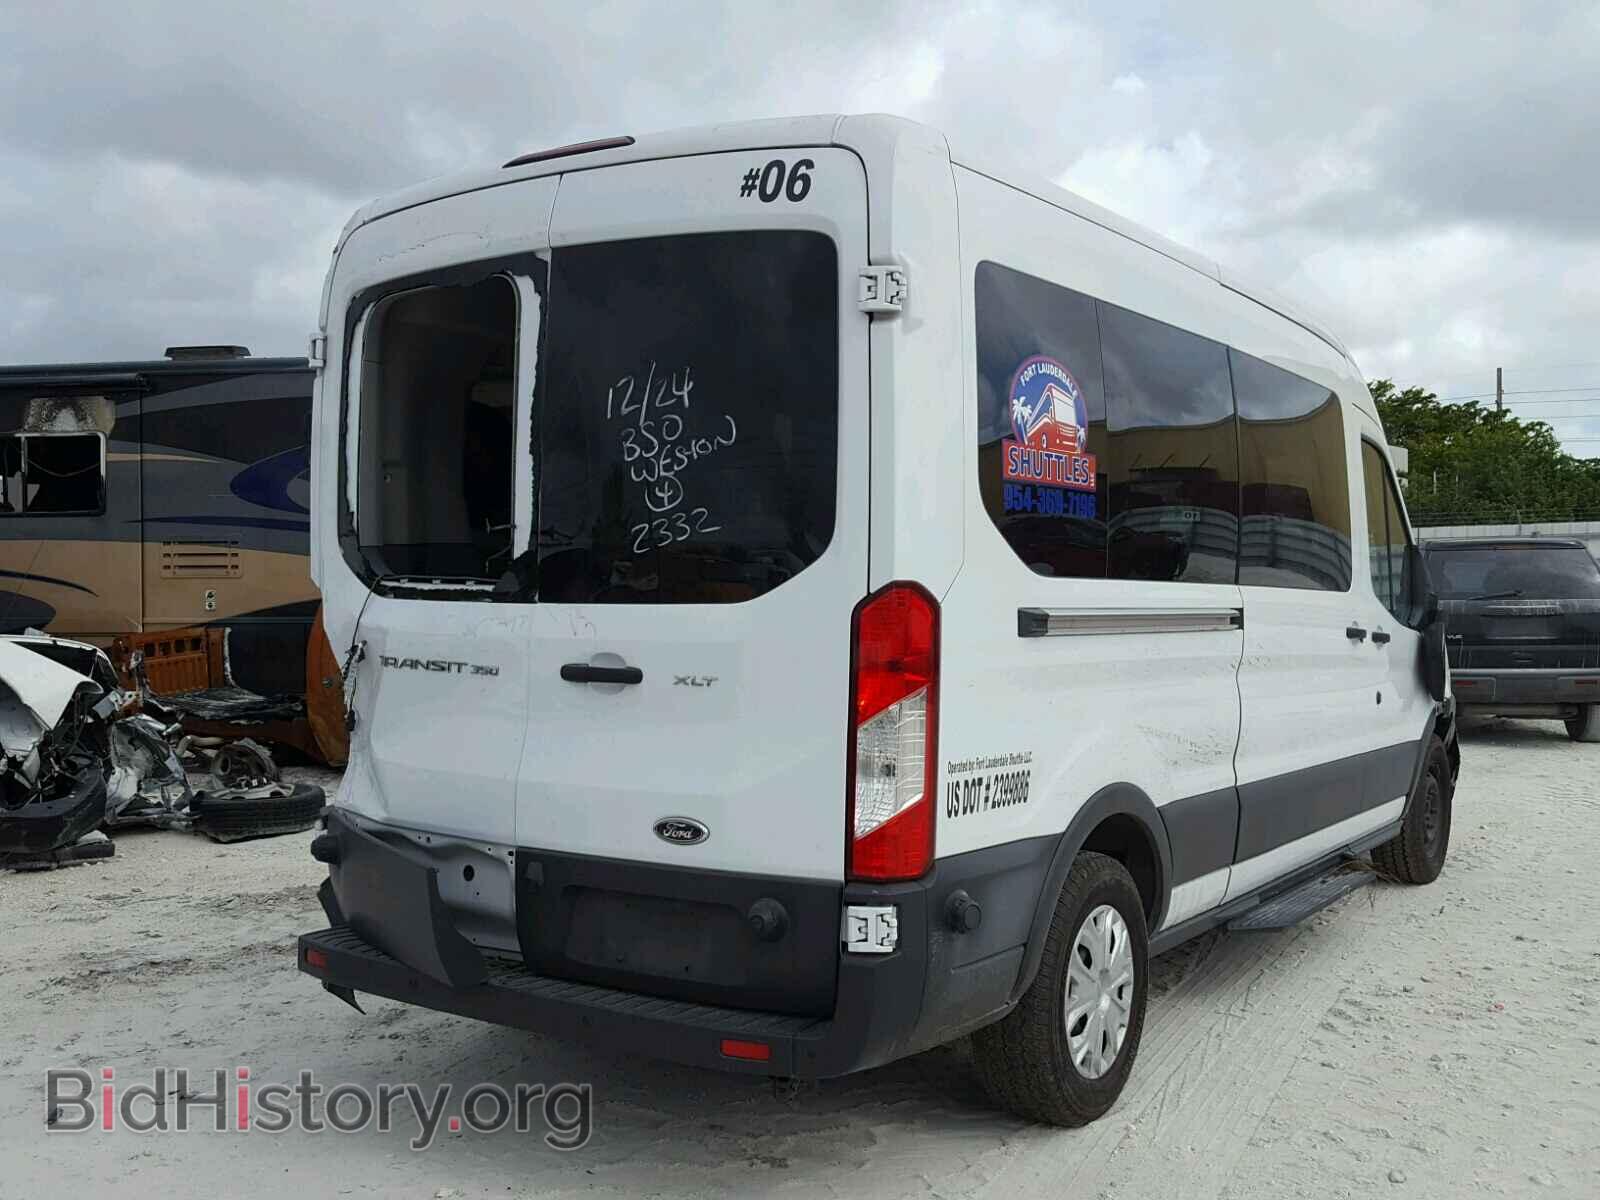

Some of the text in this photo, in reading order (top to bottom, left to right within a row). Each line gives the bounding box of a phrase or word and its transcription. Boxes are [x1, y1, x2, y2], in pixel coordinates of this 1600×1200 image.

[740, 158, 815, 203] #06
[606, 359, 694, 426] 12/24
[1020, 363, 1036, 387] FORT
[1008, 446, 1089, 485] SHUTTLES
[631, 508, 722, 554] 2332
[379, 655, 468, 674] TRANSIT
[672, 674, 720, 688] XLT
[947, 780, 960, 819] US
[962, 777, 984, 816] DOT
